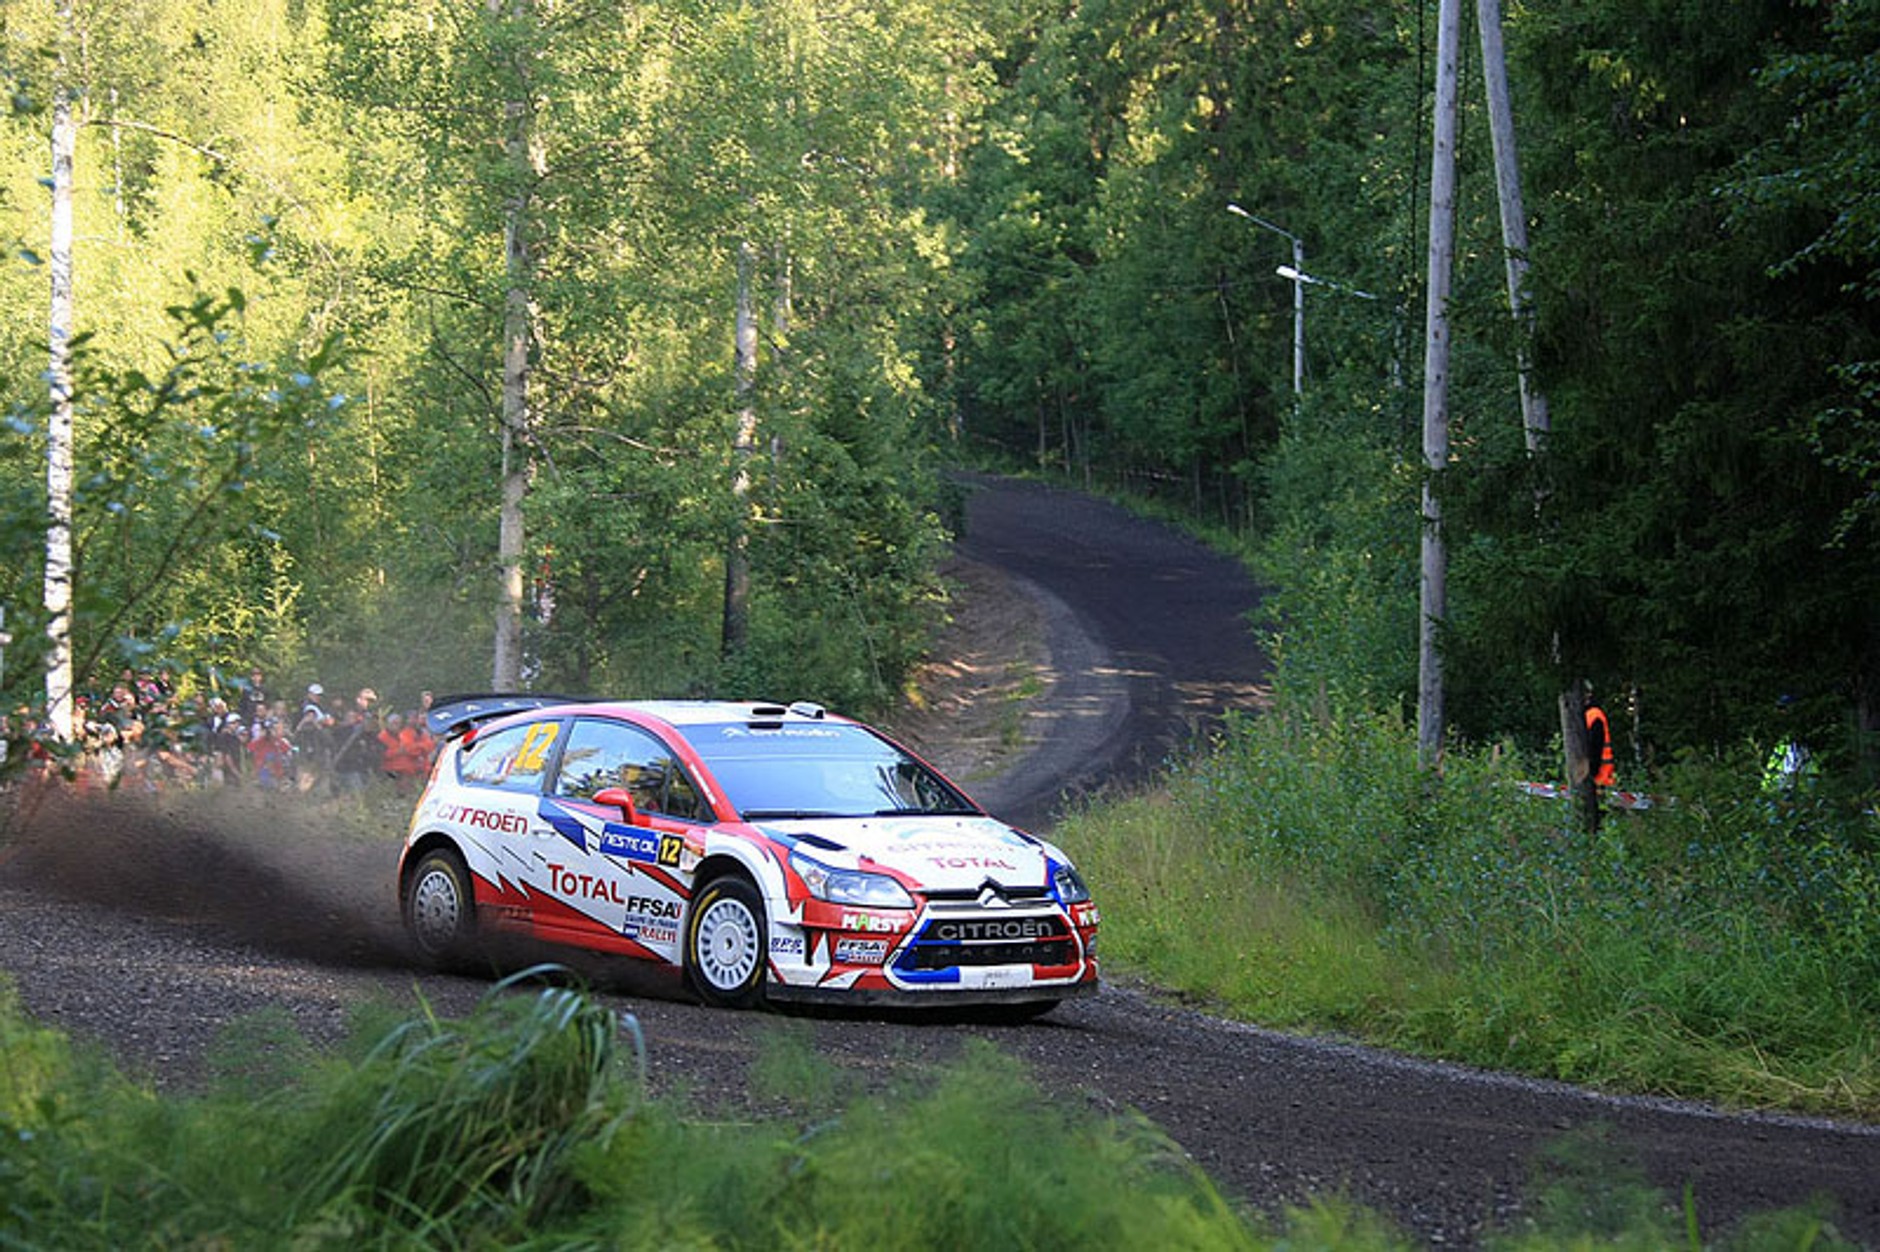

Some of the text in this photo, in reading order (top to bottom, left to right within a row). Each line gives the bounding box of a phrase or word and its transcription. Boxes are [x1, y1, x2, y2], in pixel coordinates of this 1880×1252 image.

[514, 722, 560, 770] 12
[437, 803, 528, 835] CITROËN
[660, 837, 682, 864] 12
[926, 856, 1017, 871] TOTAL
[546, 863, 626, 905] TOTAL
[627, 895, 679, 919] FFSA
[938, 918, 1054, 941] CITROËN
